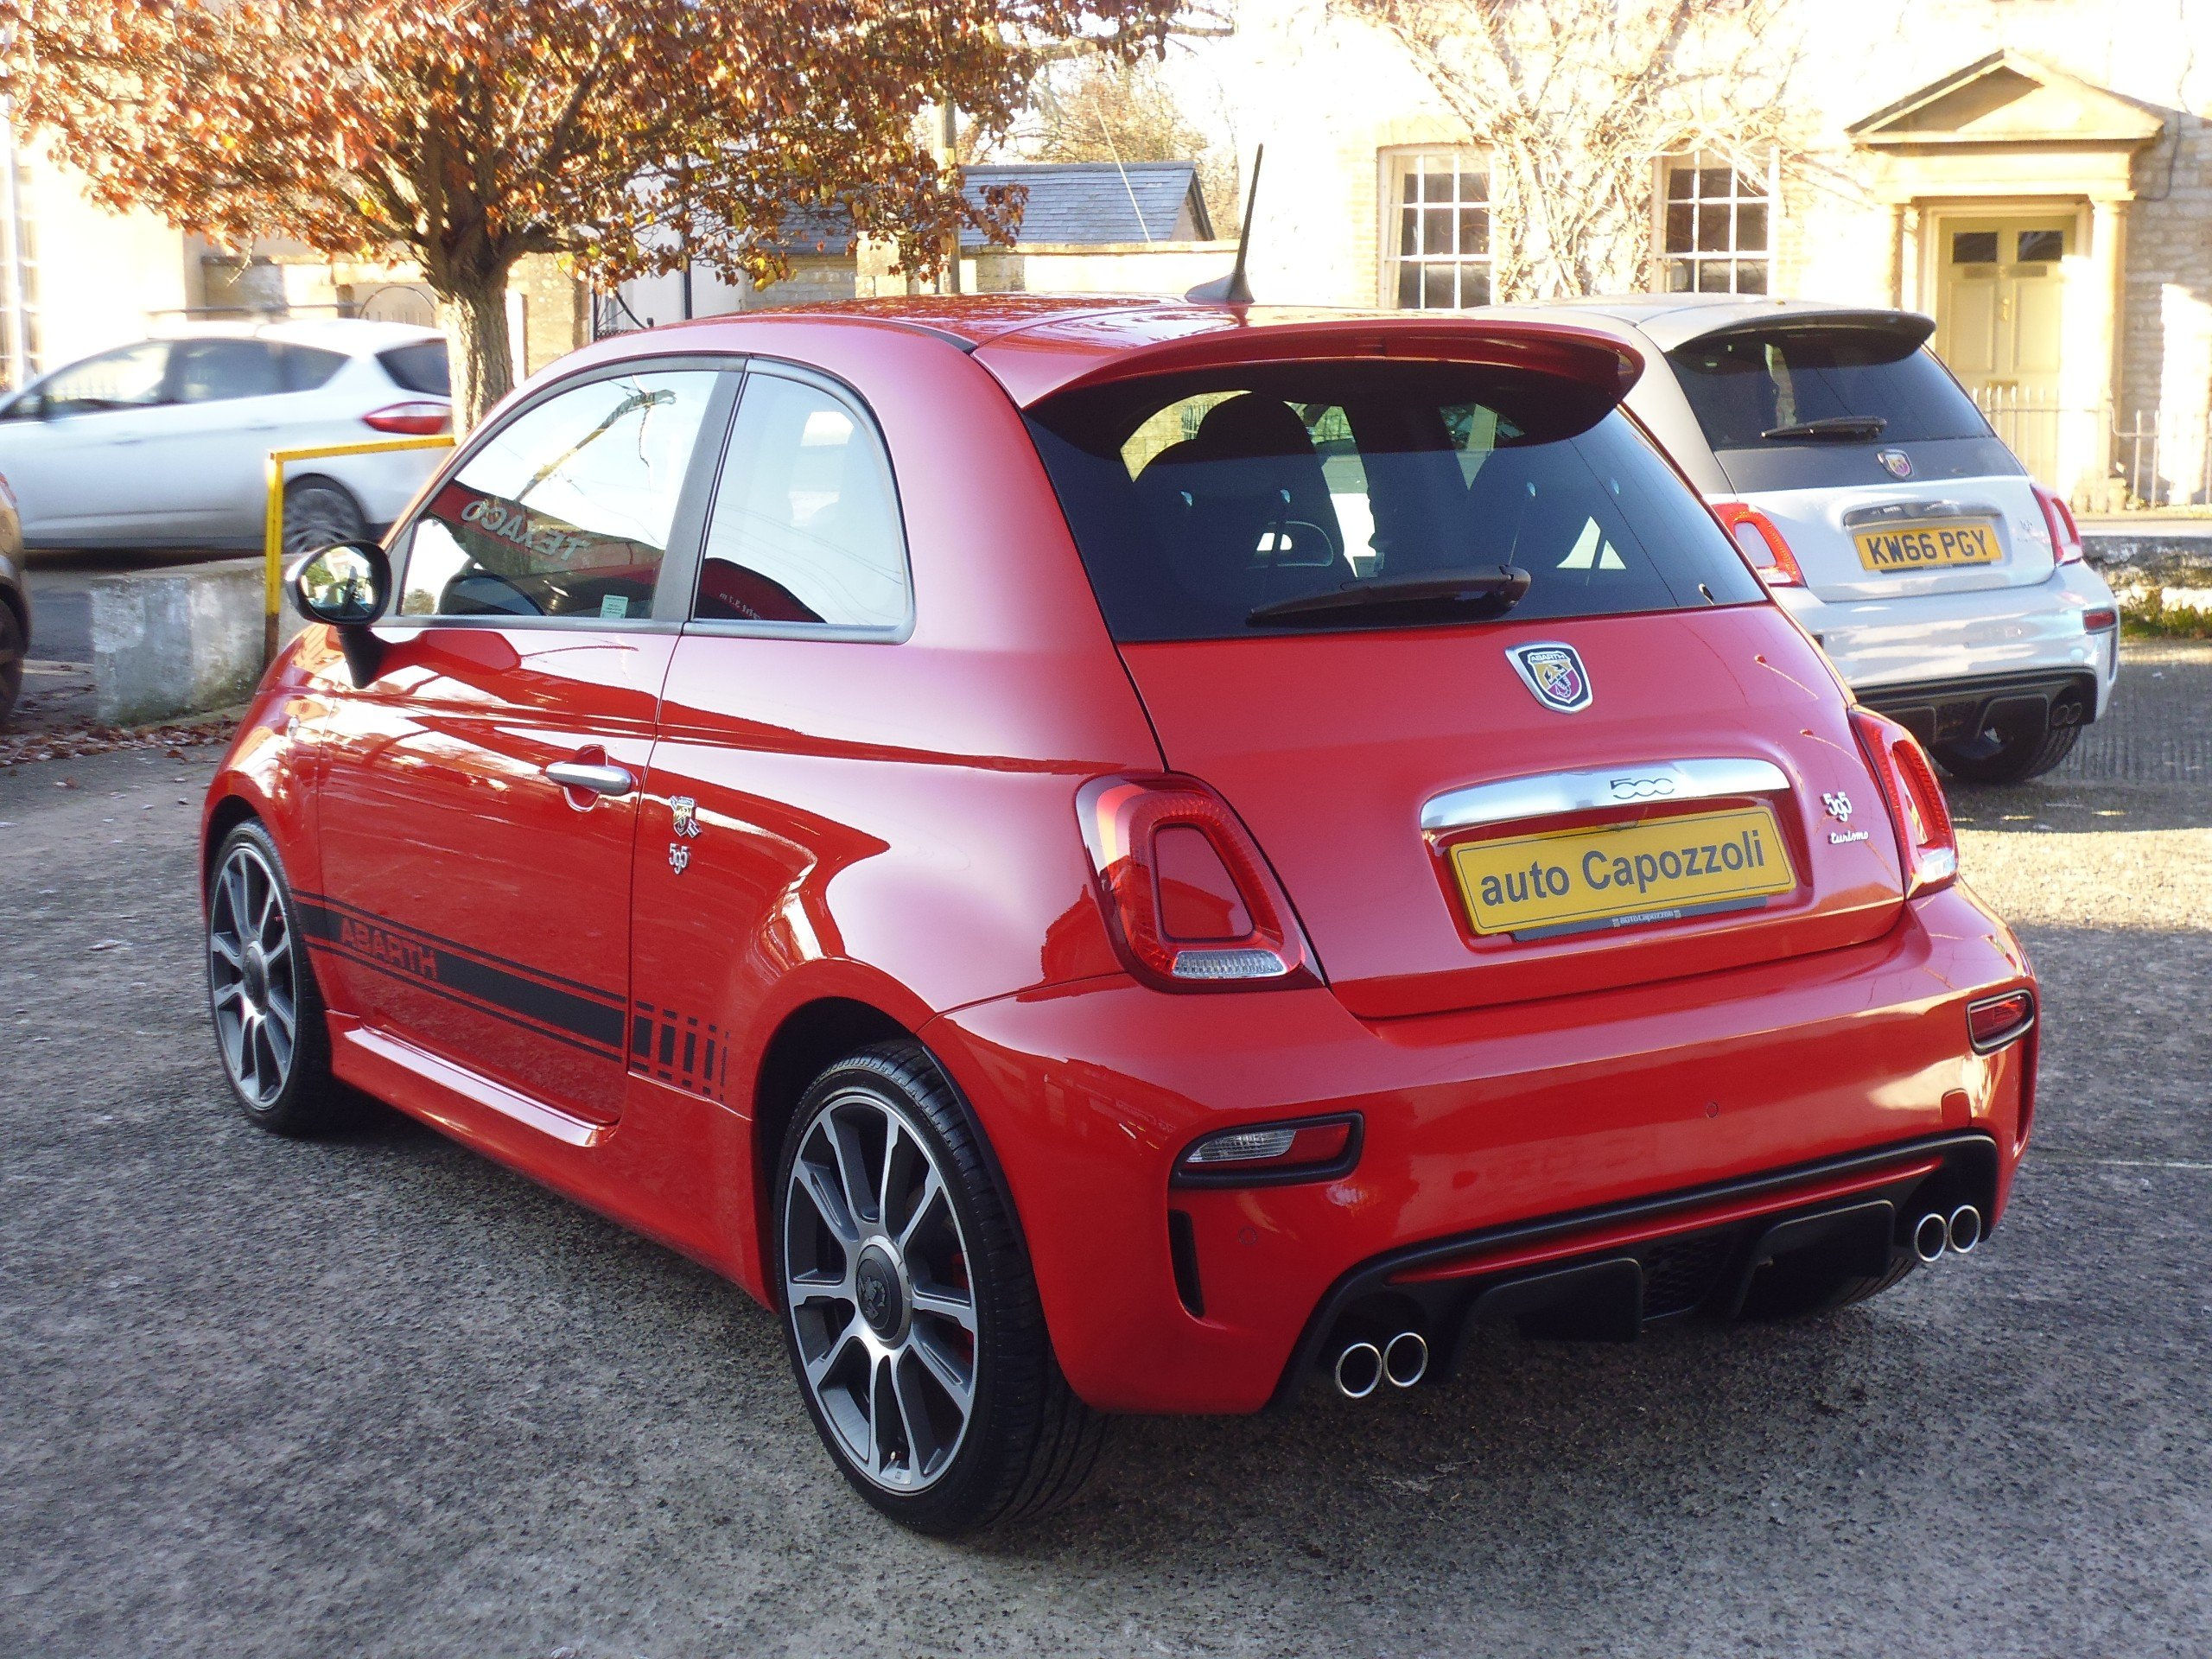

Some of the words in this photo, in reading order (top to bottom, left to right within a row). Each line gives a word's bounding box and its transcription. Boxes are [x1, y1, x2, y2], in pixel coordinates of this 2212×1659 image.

[1866, 532, 1937, 565] KW66
[1942, 529, 1987, 557] PGY
[1530, 653, 1565, 662] ABARTH
[1610, 778, 1675, 800] 500
[1823, 791, 1853, 822] 595
[669, 842, 691, 875] 595
[1480, 860, 1570, 906] auto
[1582, 830, 1764, 893] Capozzoli
[340, 915, 437, 982] ABARTH
